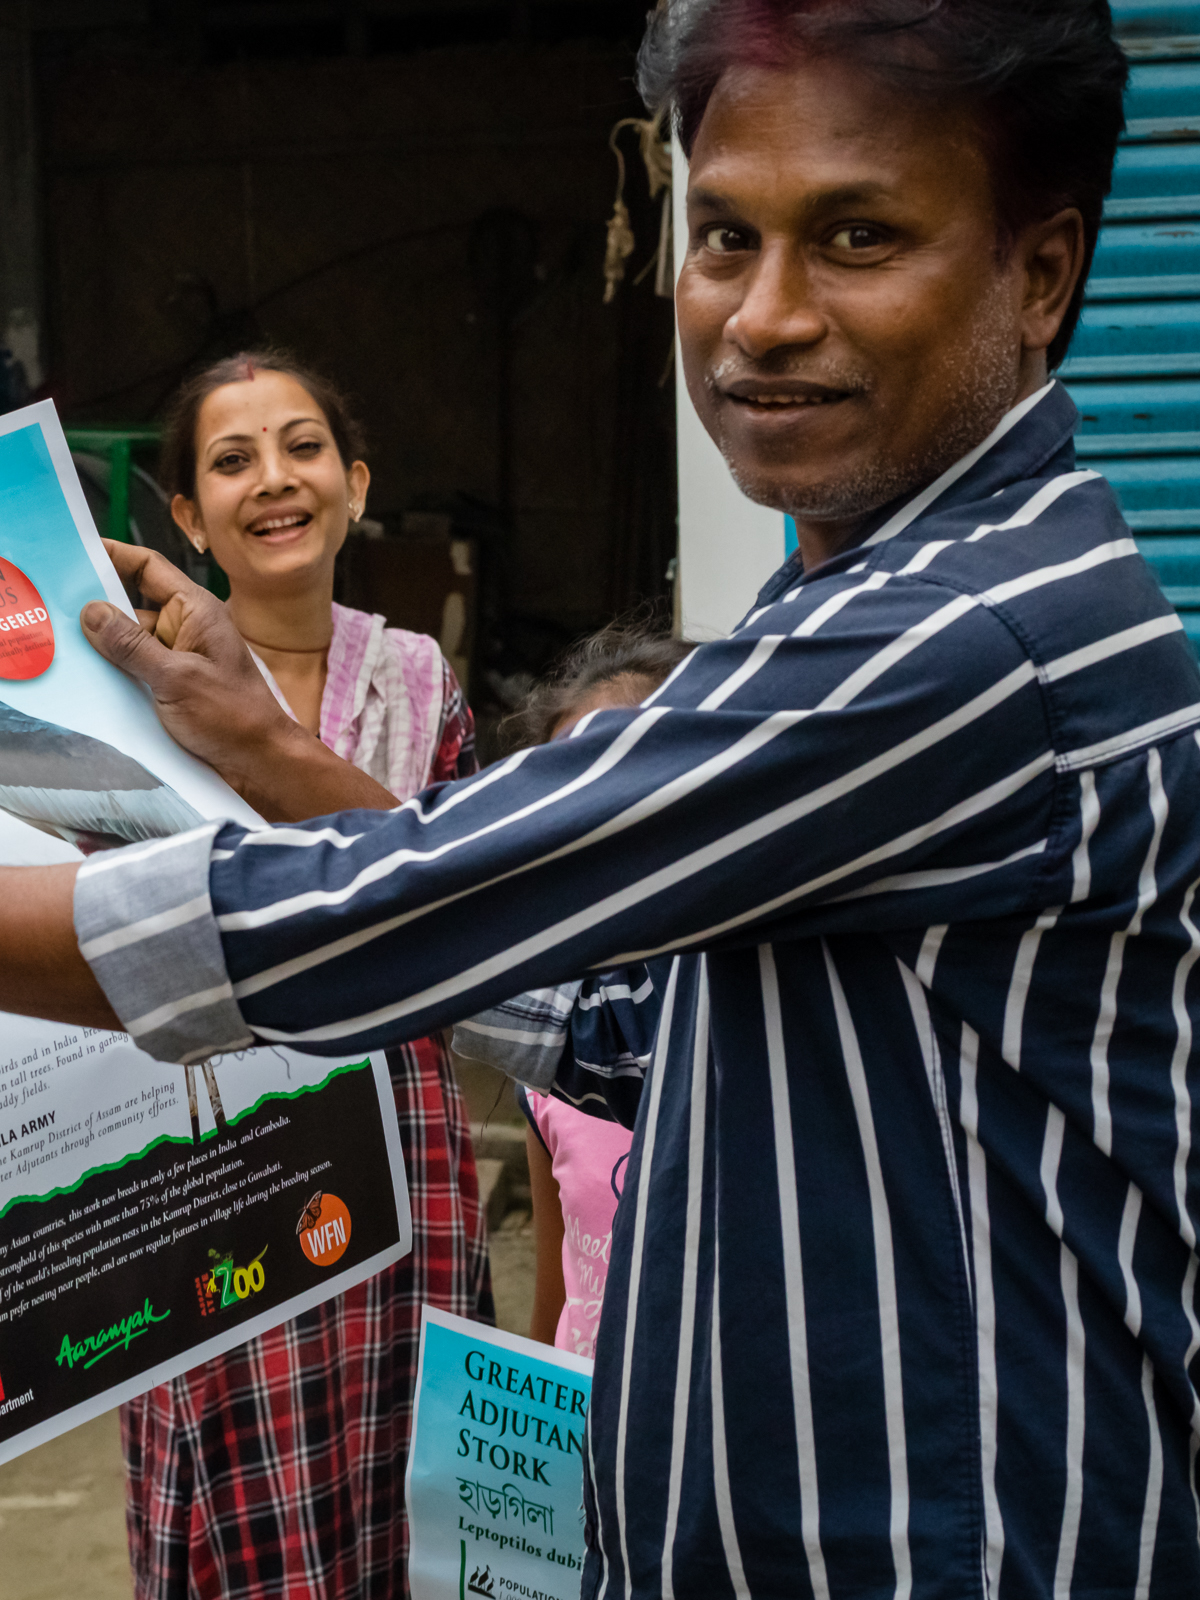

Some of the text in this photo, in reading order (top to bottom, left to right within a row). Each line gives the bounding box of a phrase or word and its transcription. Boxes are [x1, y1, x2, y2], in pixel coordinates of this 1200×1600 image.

[10, 1070, 27, 1088] tall
[29, 1064, 54, 1079] trees.
[55, 1047, 84, 1068] Found
[86, 1045, 96, 1055] in
[21, 1048, 39, 1066] and
[41, 1047, 51, 1057] in
[53, 1034, 78, 1052] India
[10, 1139, 46, 1161] Kamrup
[48, 1122, 82, 1144] District
[84, 1112, 94, 1135] of
[96, 1104, 122, 1122] Assam
[124, 1097, 138, 1109] are
[141, 1081, 175, 1102] helping
[21, 1080, 50, 1105] fields.
[21, 1110, 56, 1138] ARMY
[15, 1150, 58, 1176] Adjutants
[60, 1129, 95, 1155] through
[97, 1111, 145, 1138] community
[148, 1097, 179, 1119] efforts.
[10, 1234, 31, 1250] Asian
[32, 1218, 67, 1239] countries,
[68, 1209, 83, 1222] this
[83, 1198, 101, 1215] stork
[101, 1194, 116, 1207] now
[117, 1180, 140, 1200] breeds
[140, 1179, 149, 1189] in
[149, 1169, 165, 1185] only
[166, 1168, 172, 1178] a
[170, 1161, 185, 1180] few
[187, 1153, 208, 1173] places
[209, 1149, 217, 1159] in
[218, 1139, 237, 1155] India
[240, 1128, 254, 1145] and
[254, 1115, 291, 1138] Cambodia.
[0, 1249, 37, 1278] stronghold
[37, 1244, 46, 1263] of
[46, 1241, 61, 1255] this
[61, 1231, 85, 1251] species
[85, 1219, 102, 1236] with
[102, 1214, 121, 1228] more
[121, 1205, 139, 1220] than
[139, 1195, 160, 1211] 75%
[160, 1187, 169, 1205] of
[169, 1185, 181, 1198] the
[182, 1172, 204, 1197] global
[205, 1159, 245, 1186] population.
[3, 1283, 12, 1301] of
[12, 1280, 25, 1294] the
[25, 1266, 51, 1287] world's
[50, 1254, 82, 1275] breeding
[82, 1235, 121, 1264] population
[122, 1227, 140, 1241] nests
[140, 1223, 149, 1233] in
[149, 1216, 162, 1229] the
[162, 1203, 192, 1223] Kamrup
[193, 1190, 222, 1209] District,
[221, 1182, 238, 1196] close
[238, 1178, 247, 1188] to
[247, 1161, 283, 1184] Guwahati.
[9, 1299, 30, 1322] prefer
[31, 1288, 57, 1307] nesting
[57, 1279, 74, 1294] near
[75, 1266, 101, 1290] people,
[100, 1256, 115, 1273] and
[116, 1254, 128, 1266] are
[129, 1247, 144, 1260] now
[145, 1234, 173, 1254] regular
[171, 1221, 200, 1245] features
[200, 1218, 208, 1227] in
[209, 1206, 232, 1223] village
[233, 1197, 244, 1215] life
[245, 1189, 269, 1206] during
[269, 1182, 281, 1196] the
[280, 1170, 309, 1190] breeding
[309, 1160, 333, 1176] season.
[306, 1216, 347, 1258] WFN
[55, 1297, 171, 1368] Aaranyak
[464, 1350, 586, 1418] GREATER
[457, 1389, 583, 1456] ADJUTAN
[457, 1428, 552, 1487] STORK
[458, 1516, 542, 1558] Leptoptilos
